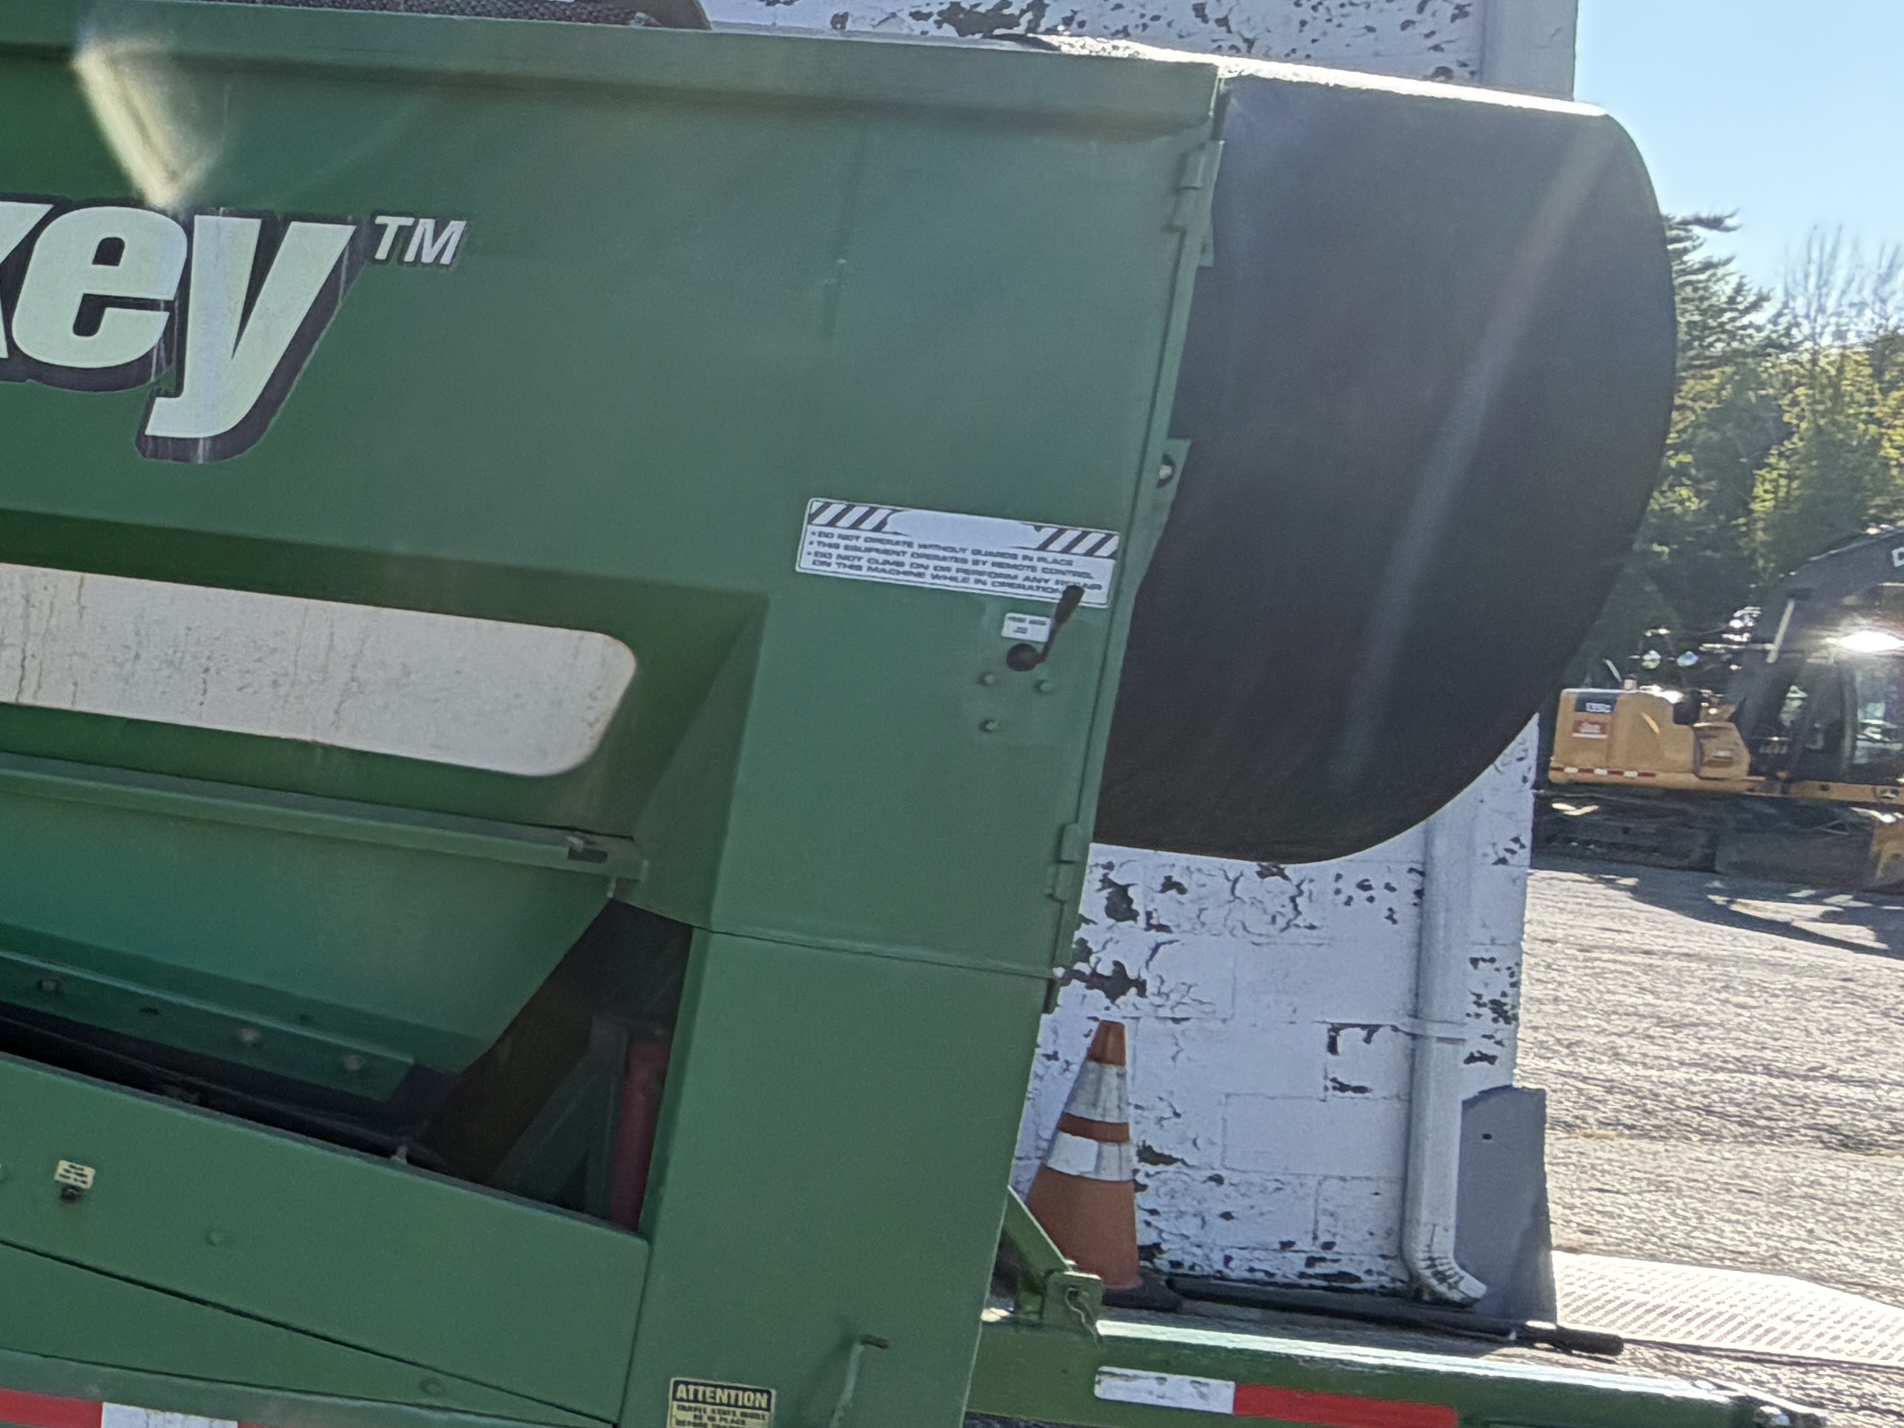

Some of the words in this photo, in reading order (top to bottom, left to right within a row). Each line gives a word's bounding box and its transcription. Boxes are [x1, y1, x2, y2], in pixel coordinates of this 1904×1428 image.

[374, 215, 467, 265] TM
[816, 541, 840, 550] THIS
[817, 531, 835, 539] DO
[837, 533, 861, 542] NOT
[863, 536, 914, 549] OPERATE
[917, 542, 969, 554] WITHOUT
[812, 559, 832, 568] ON
[835, 562, 863, 572] THIS
[813, 551, 833, 560] DO
[836, 553, 864, 562] NOT
[1022, 575, 1051, 585] ANY
[675, 1383, 768, 1409] ATTENTION
